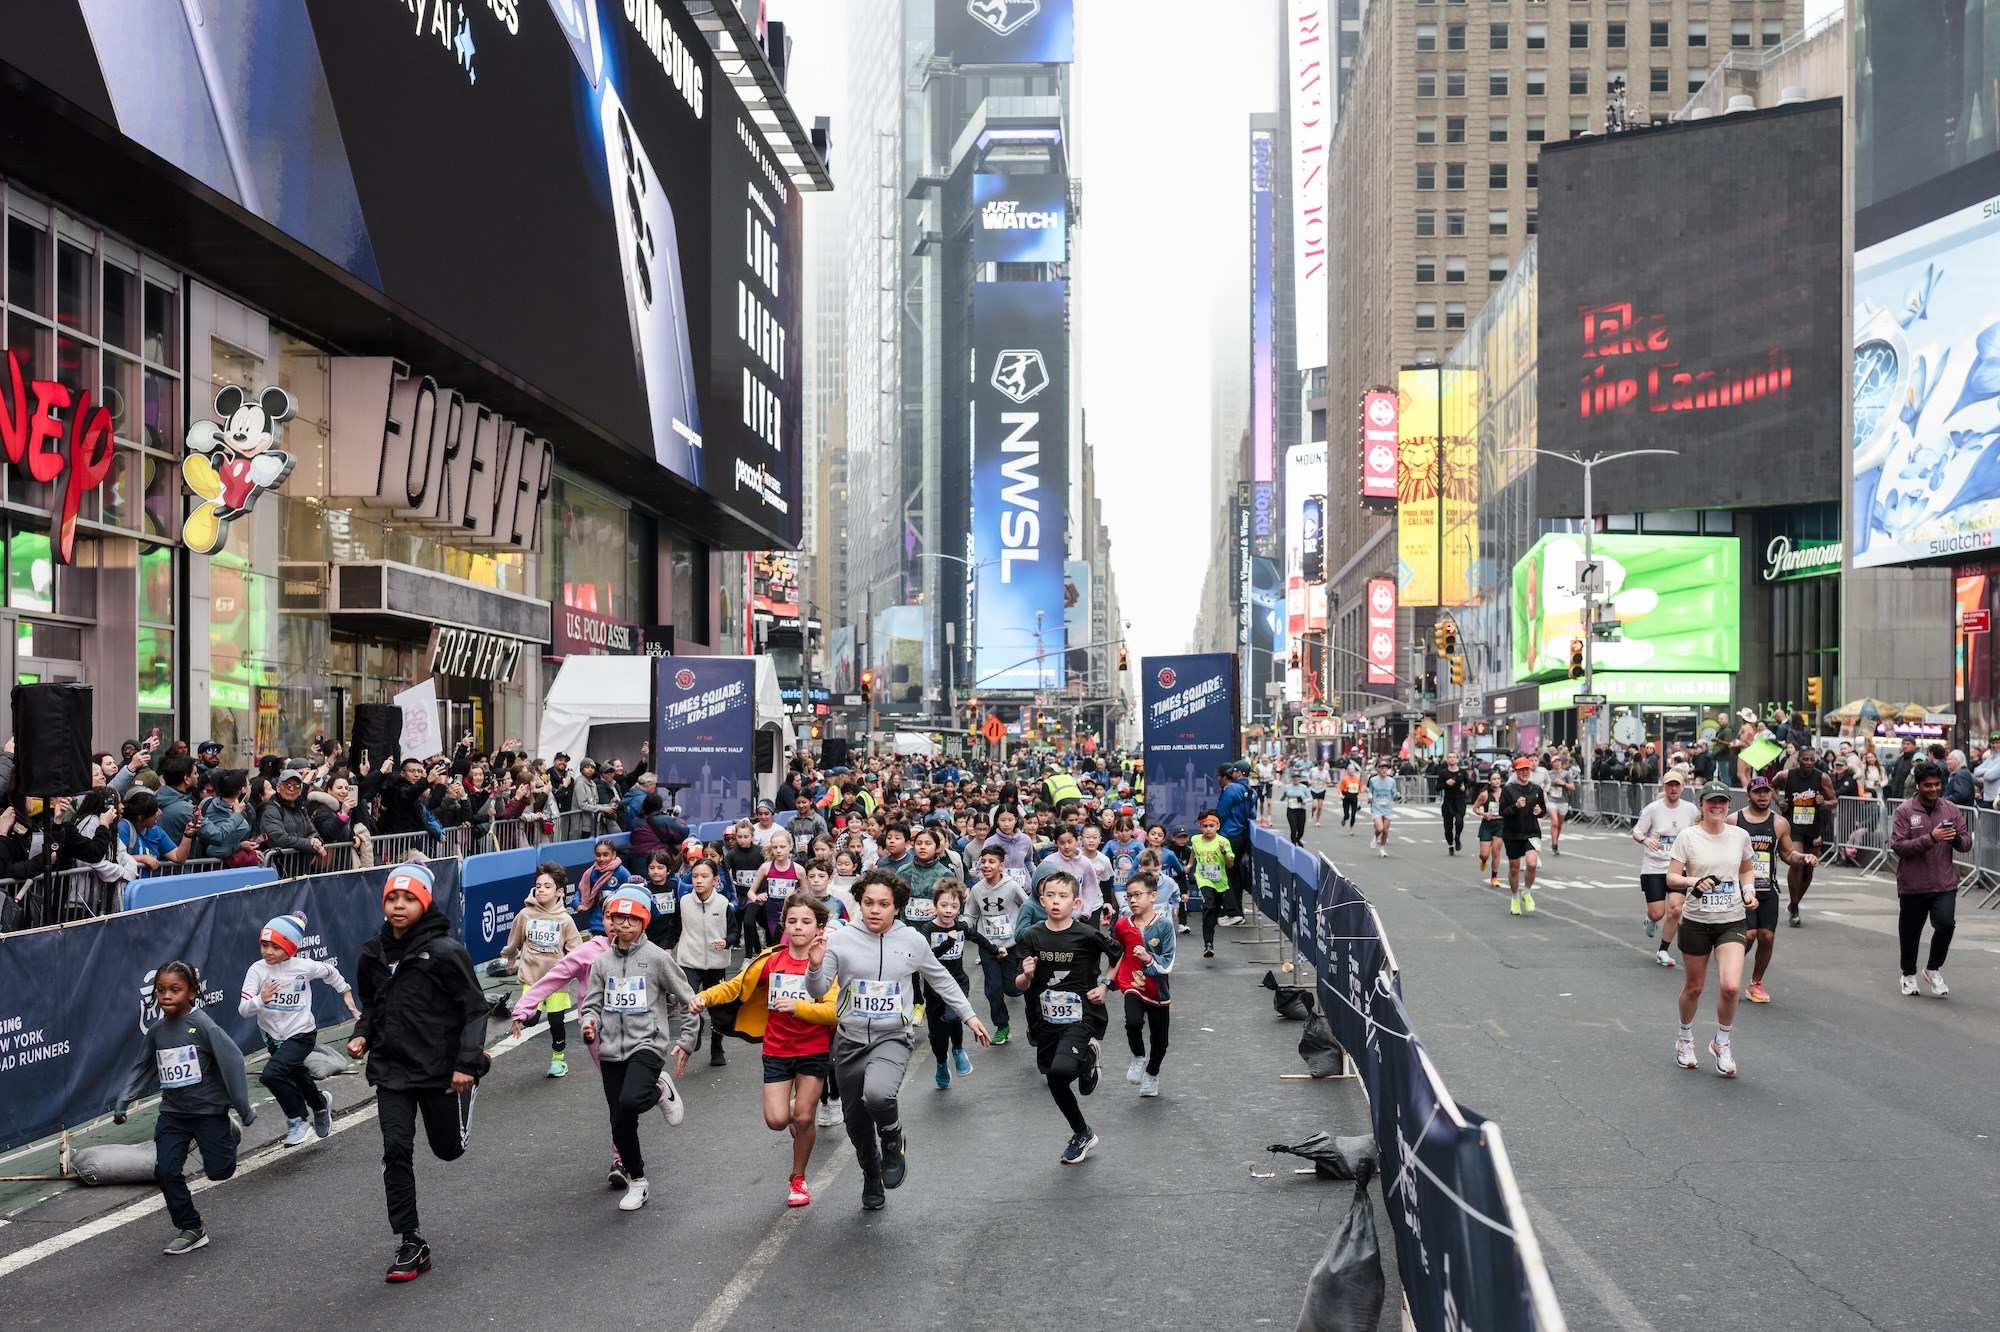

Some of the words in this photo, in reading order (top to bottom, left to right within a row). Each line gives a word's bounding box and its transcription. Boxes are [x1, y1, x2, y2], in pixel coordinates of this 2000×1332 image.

[982, 201, 1019, 213] JUST
[982, 212, 1058, 229] WATCH
[376, 355, 554, 554] FOREVER
[1001, 412, 1040, 583] NWSL
[1240, 510, 1250, 537] Winery
[1240, 538, 1248, 546] &
[1930, 532, 1981, 554] swatch
[1240, 547, 1249, 580] Vineyard
[1240, 581, 1248, 603] Estate
[1579, 584, 1600, 592] ONLY
[566, 612, 582, 640] U.S.
[583, 617, 606, 645] POLO
[607, 623, 631, 650] ASSN.
[430, 627, 502, 679] FOREVER
[646, 642, 662, 650] U.S.
[646, 649, 671, 658] POLO
[1635, 682, 1654, 694] BY
[1663, 682, 1696, 694] LINE
[668, 694, 701, 719] TIMES
[701, 680, 742, 707] SQUARE
[1152, 692, 1182, 717] TIMES
[1182, 675, 1221, 706] SQUARE
[1466, 697, 1481, 708] 25
[687, 706, 708, 725] KIDS
[708, 700, 727, 718] RUN
[794, 703, 814, 713] AC
[1170, 704, 1191, 723] KIDS
[1190, 697, 1207, 715] RUN
[415, 709, 428, 733] GO
[566, 883, 576, 893] TATA
[1702, 896, 1708, 904] B
[1709, 895, 1733, 906] 13255
[497, 904, 509, 913] RISING
[907, 908, 912, 916] H
[497, 914, 505, 923] NEW
[527, 930, 533, 940] H
[534, 930, 555, 942] 1693
[1039, 951, 1054, 962] PS
[615, 993, 637, 1006] 959
[770, 991, 776, 1002] H
[854, 996, 861, 1009] H
[864, 997, 894, 1012] 1825
[1042, 1005, 1049, 1015] H
[1051, 1005, 1073, 1017] 393
[14, 1029, 44, 1049] YORK
[0, 1056, 16, 1072] AD
[19, 1040, 71, 1067] RUNNERS
[163, 1064, 193, 1082] 1692
